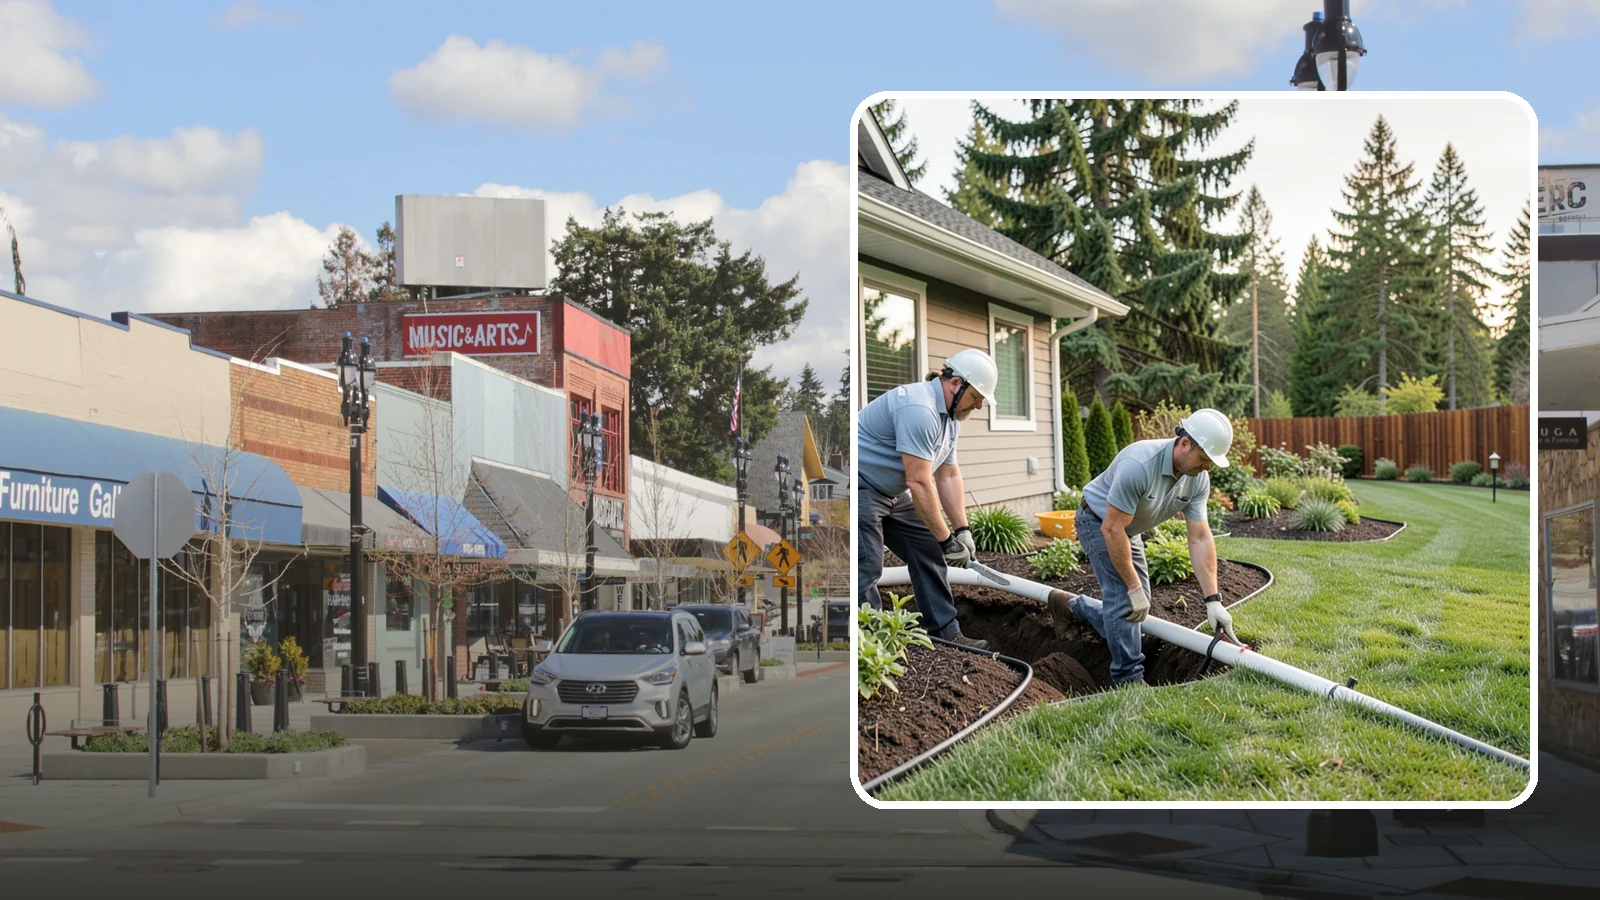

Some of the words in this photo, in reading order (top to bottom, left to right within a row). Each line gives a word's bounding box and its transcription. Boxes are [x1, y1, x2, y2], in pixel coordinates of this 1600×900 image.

[409, 322, 520, 348] MUSIC&ARTS
[1540, 427, 1577, 436] UGA
[0, 471, 79, 515] Furniture
[89, 482, 122, 519] Gal
[452, 563, 479, 574] SUSHI
[327, 594, 341, 607] HAIR
